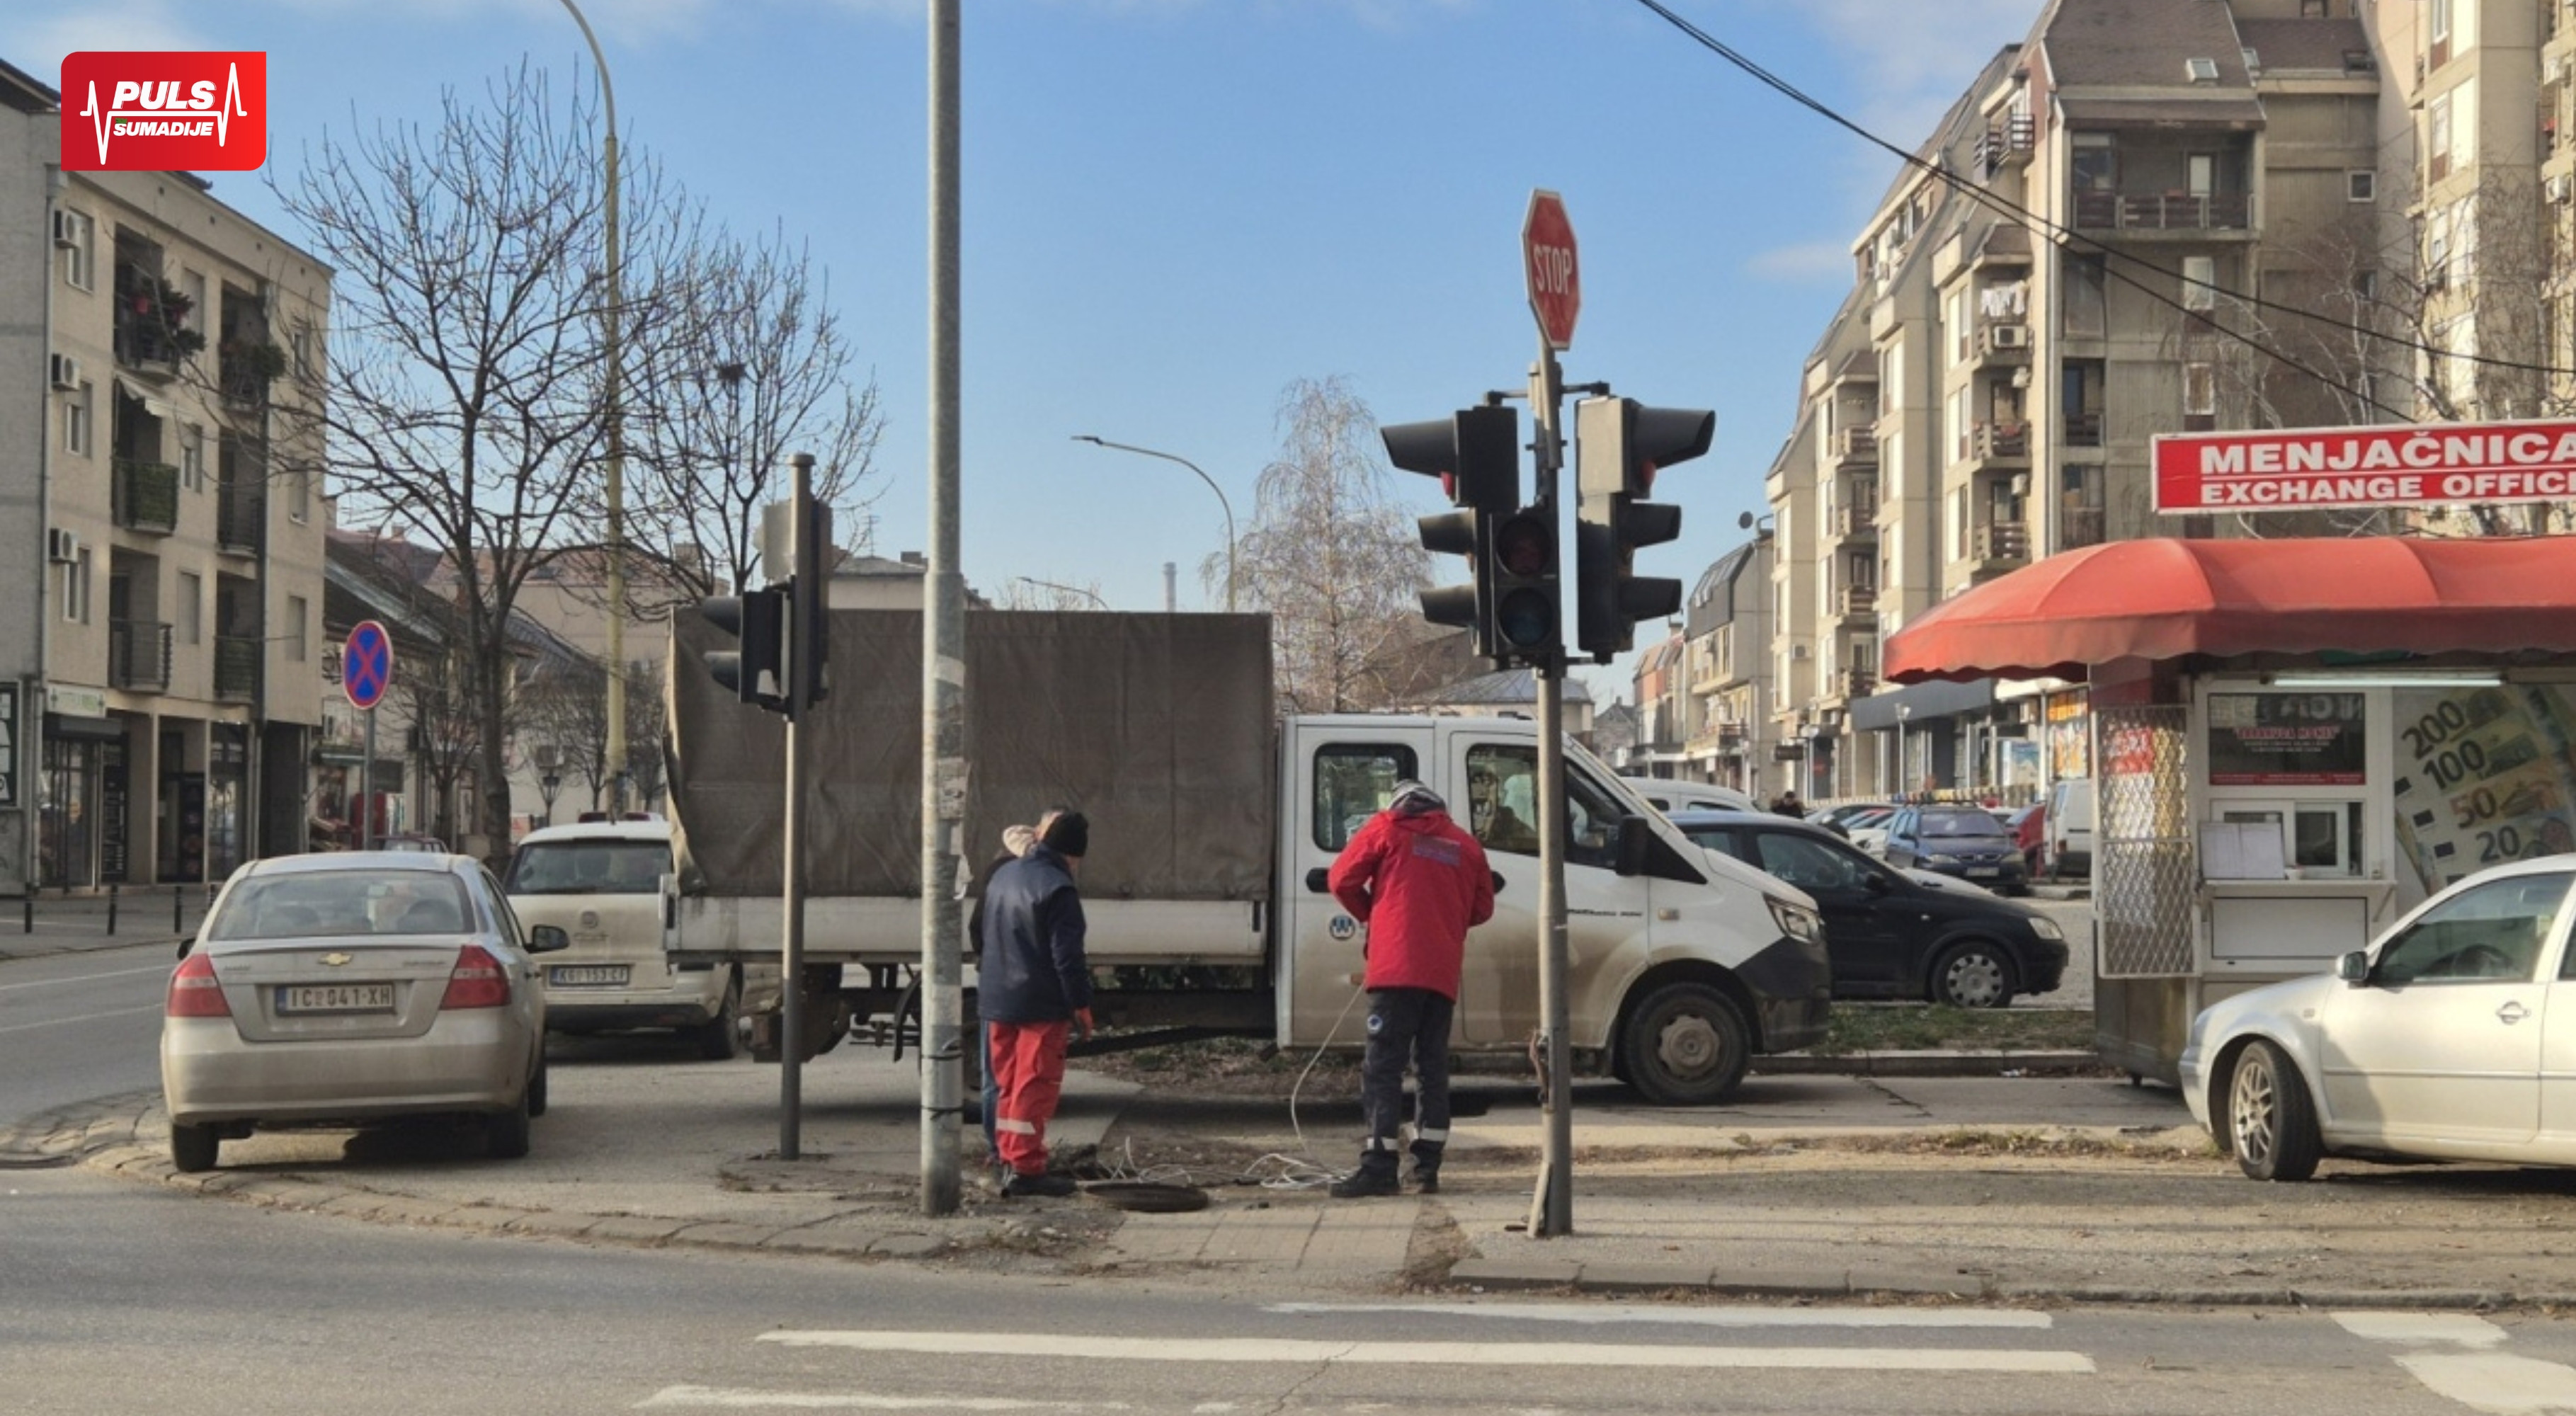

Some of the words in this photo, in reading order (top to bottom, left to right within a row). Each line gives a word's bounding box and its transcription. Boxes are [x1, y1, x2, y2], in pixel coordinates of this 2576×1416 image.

[1534, 244, 1572, 295] STOP
[2200, 431, 2576, 474] MENJAČNICA
[2200, 476, 2422, 504] EXCHANGE
[2401, 700, 2465, 760] 200
[2423, 738, 2485, 791] 100
[2449, 787, 2497, 830] 50
[2475, 825, 2521, 864] 20
